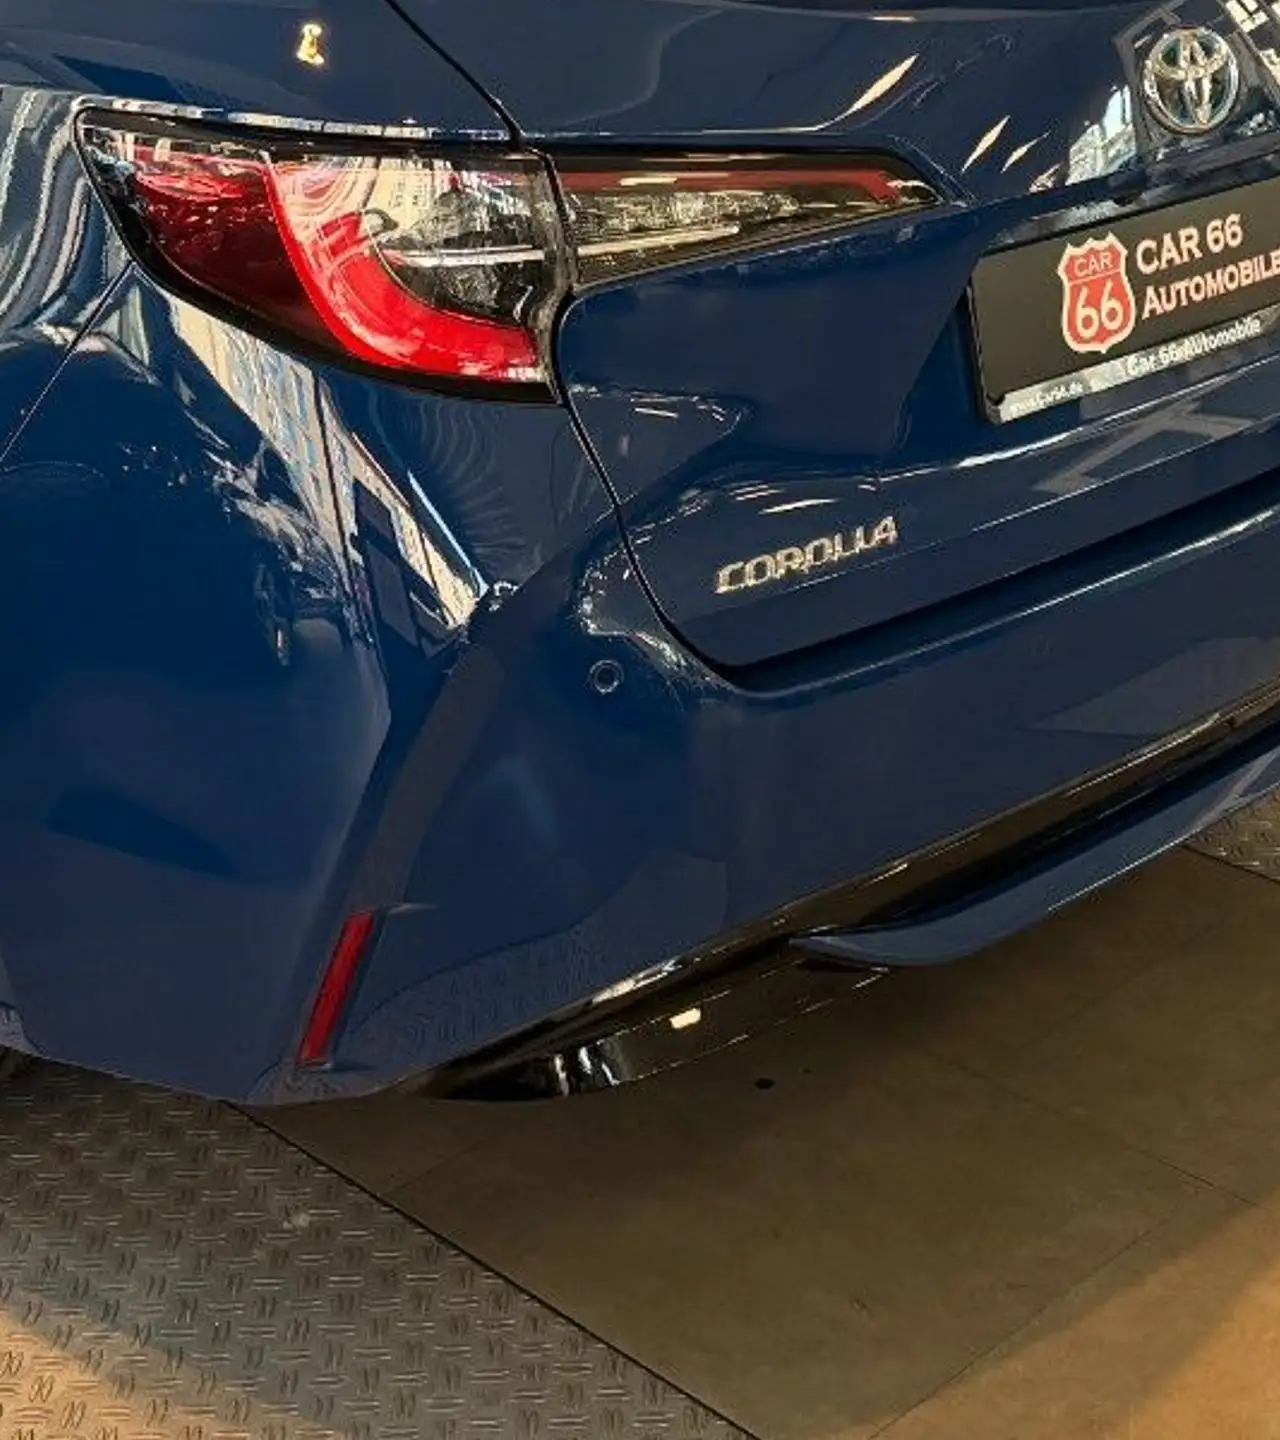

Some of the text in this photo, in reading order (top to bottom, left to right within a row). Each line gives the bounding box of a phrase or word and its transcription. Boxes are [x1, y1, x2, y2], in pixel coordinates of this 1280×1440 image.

[1073, 251, 1114, 277] CAR
[1135, 212, 1243, 275] CAR 66
[1075, 278, 1124, 339] 66
[714, 514, 898, 594] COROLLA
